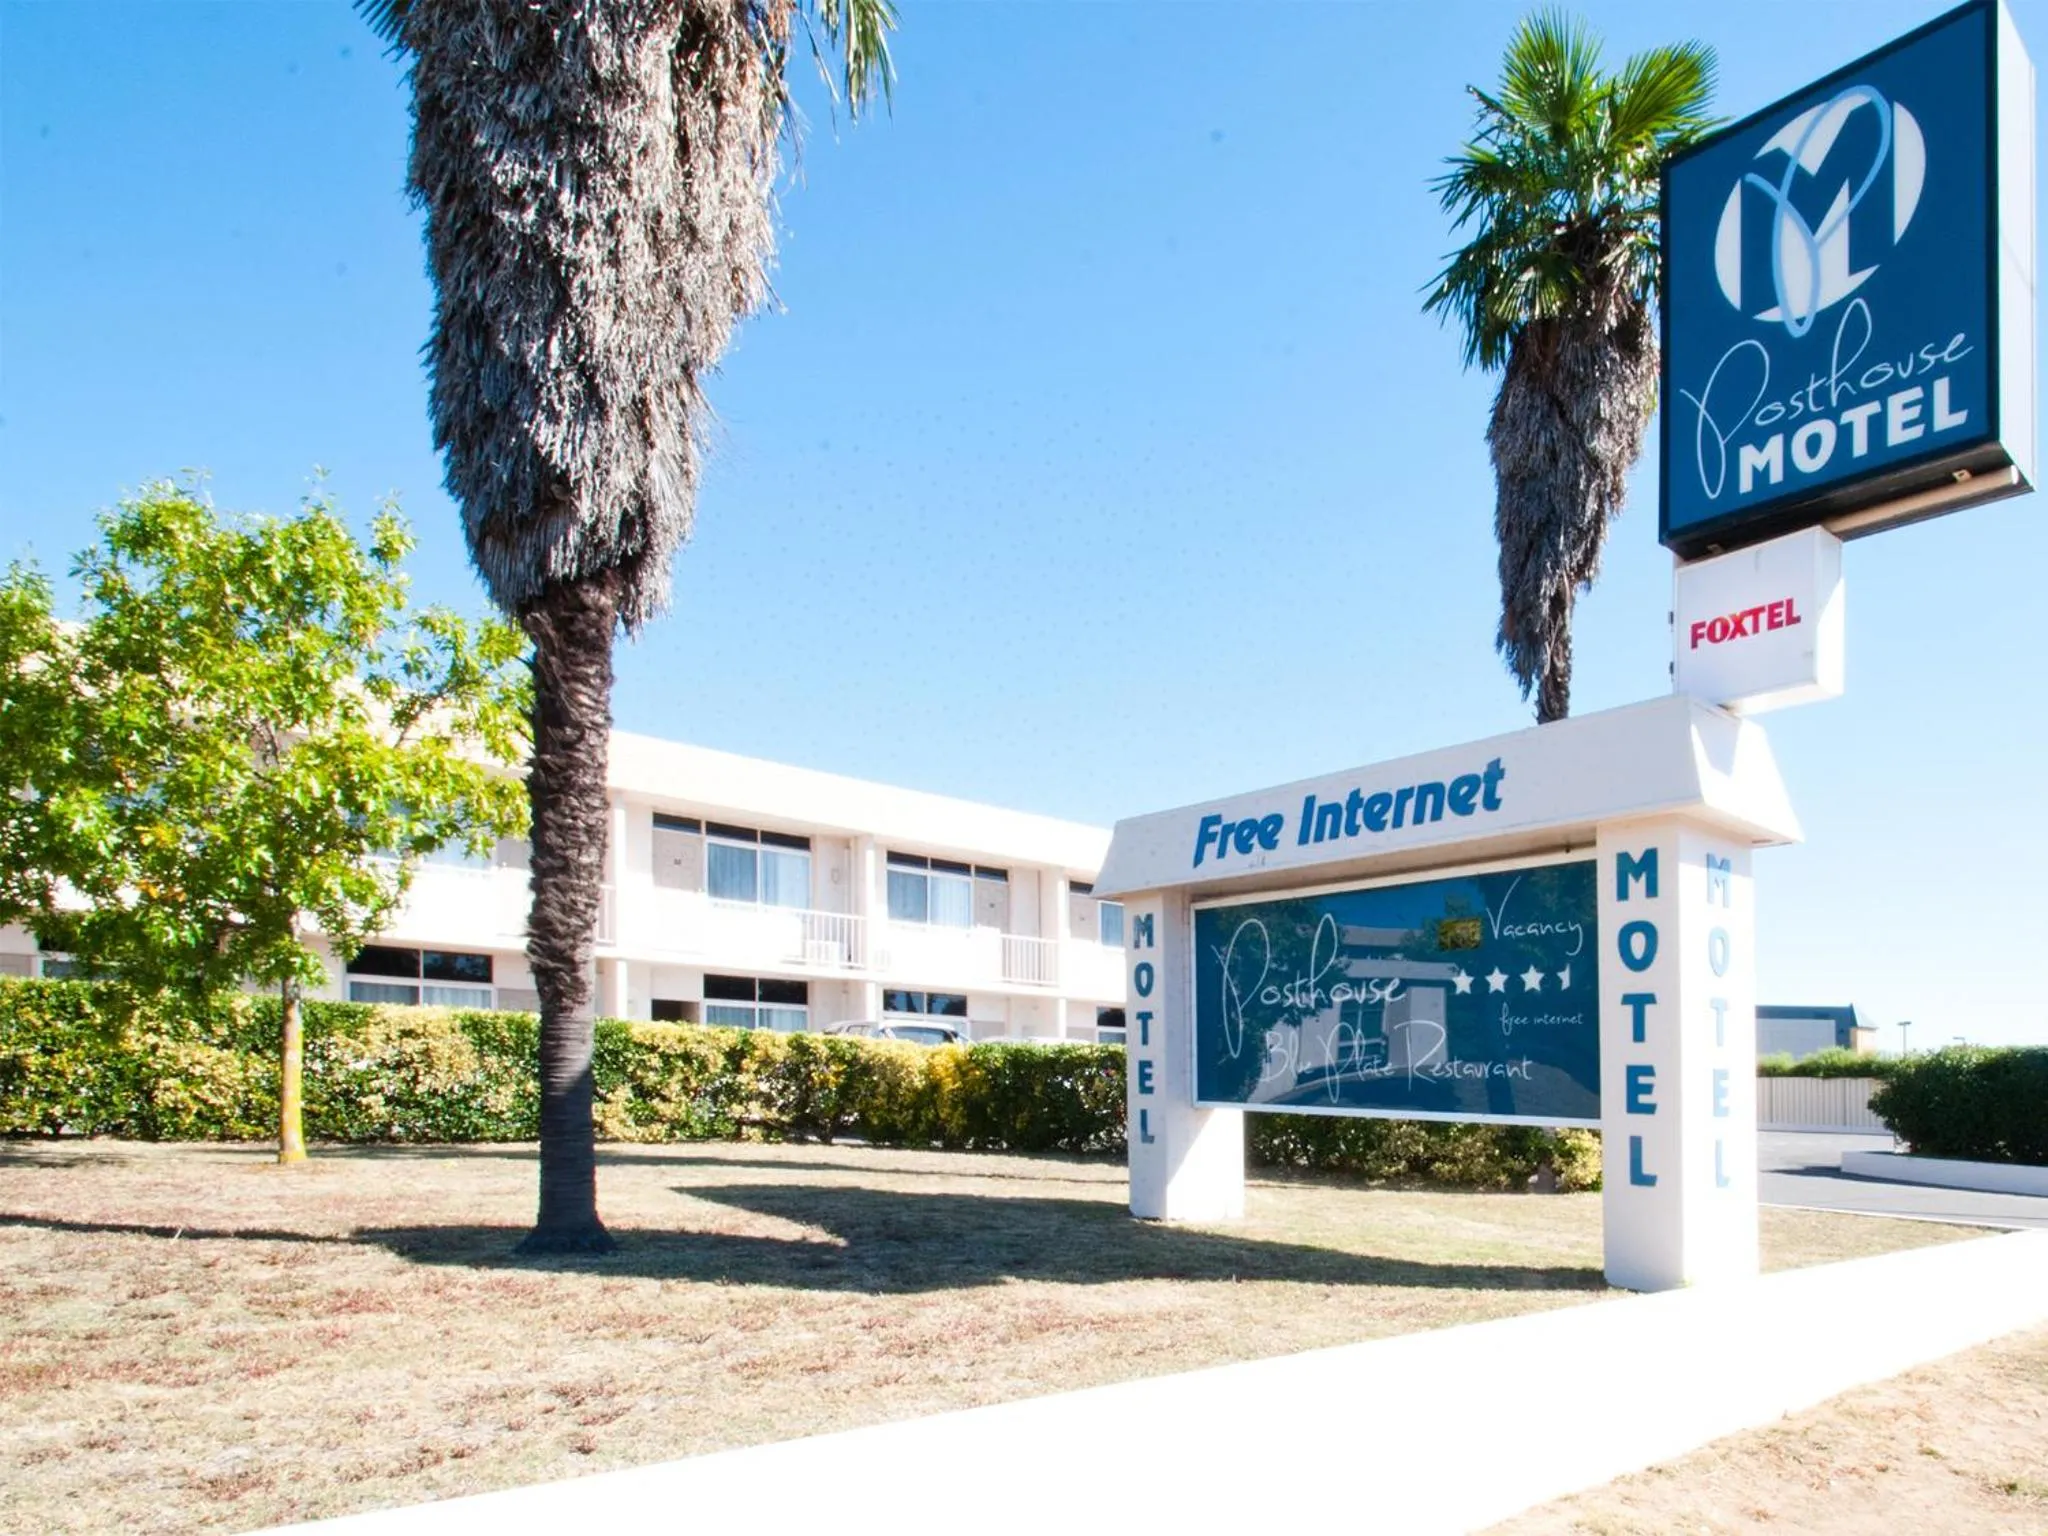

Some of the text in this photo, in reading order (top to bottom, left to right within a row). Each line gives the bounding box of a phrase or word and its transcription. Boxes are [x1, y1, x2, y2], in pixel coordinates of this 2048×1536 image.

[1679, 297, 1975, 499] Posthouse
[1738, 376, 1969, 495] MOTEL
[1690, 597, 1801, 650] FOXTEL
[1193, 757, 1506, 868] Free Internet
[1486, 876, 1583, 956] Vacancy
[1133, 912, 1156, 1145] MOTEL
[1210, 913, 1406, 1059] Posthouse
[1500, 1001, 1584, 1036] free internet
[1616, 847, 1659, 1187] MOTEL
[1706, 852, 1732, 1188] MOTEL
[1393, 1019, 1533, 1093] Restaurant
